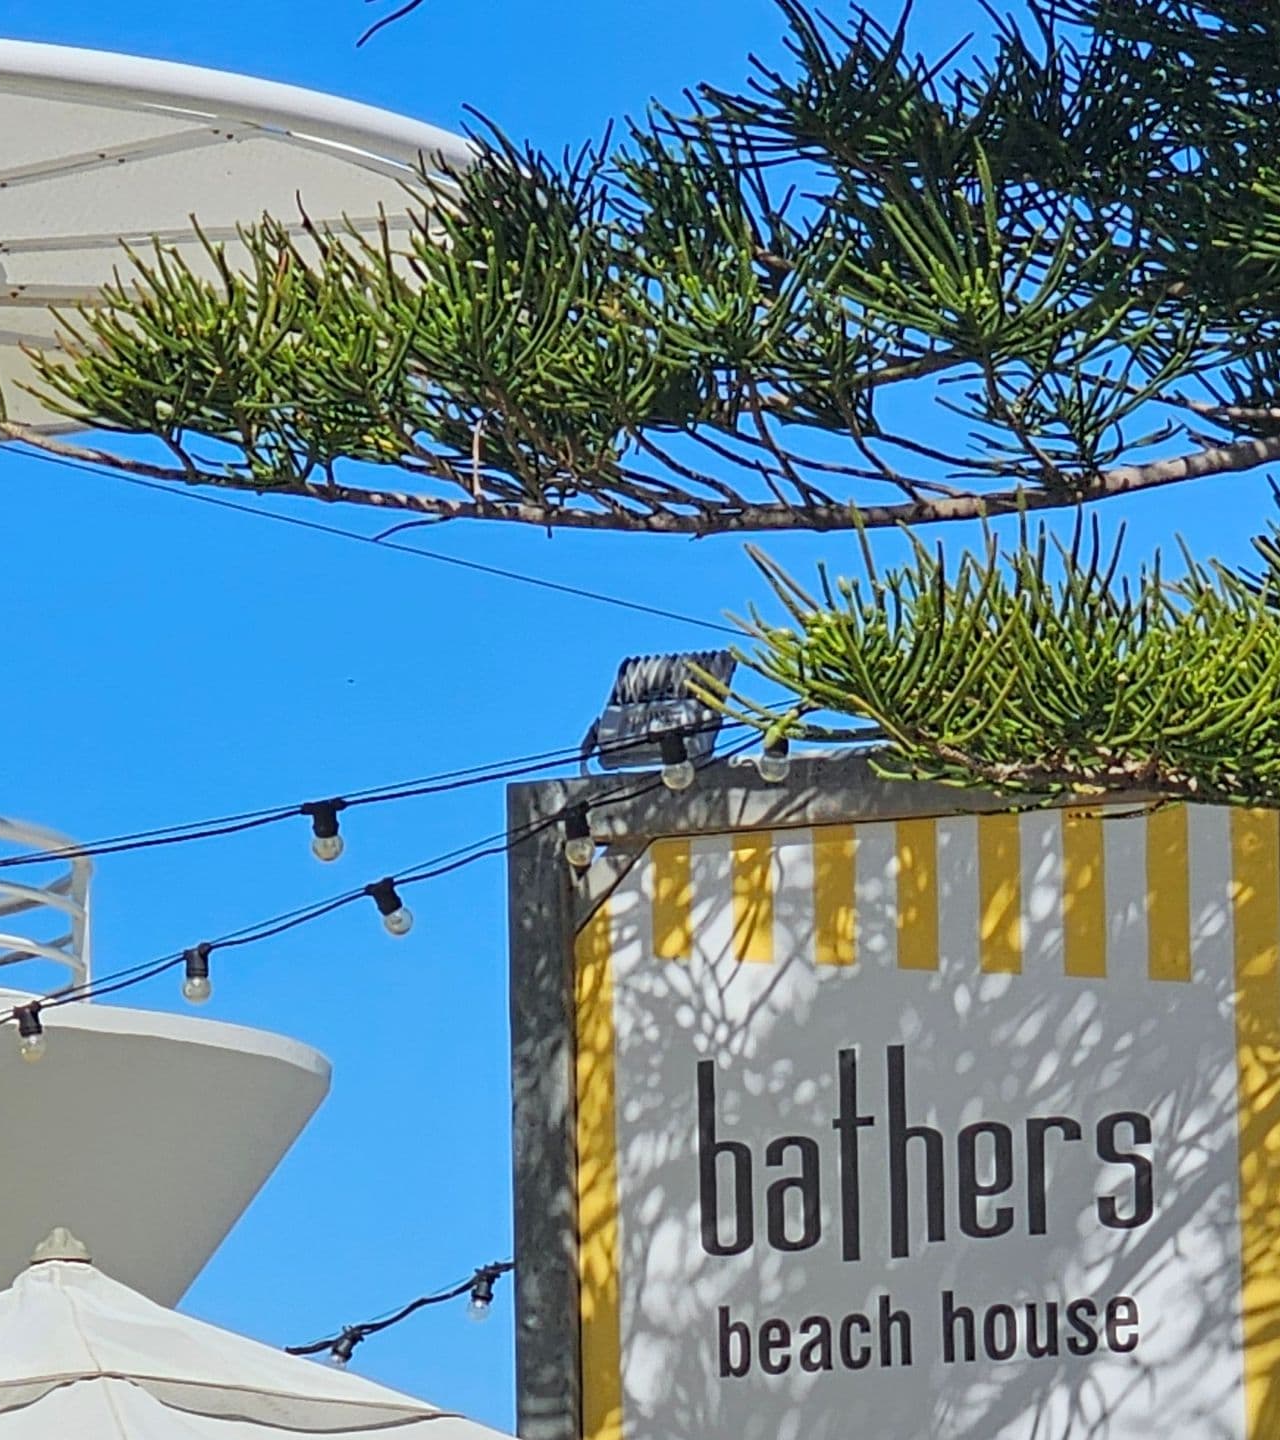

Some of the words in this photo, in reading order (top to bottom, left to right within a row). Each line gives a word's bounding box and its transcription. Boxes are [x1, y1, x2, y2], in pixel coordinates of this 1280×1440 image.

[697, 1044, 1154, 1262] bathers
[718, 1294, 913, 1378] beach
[942, 1290, 1140, 1363] house
